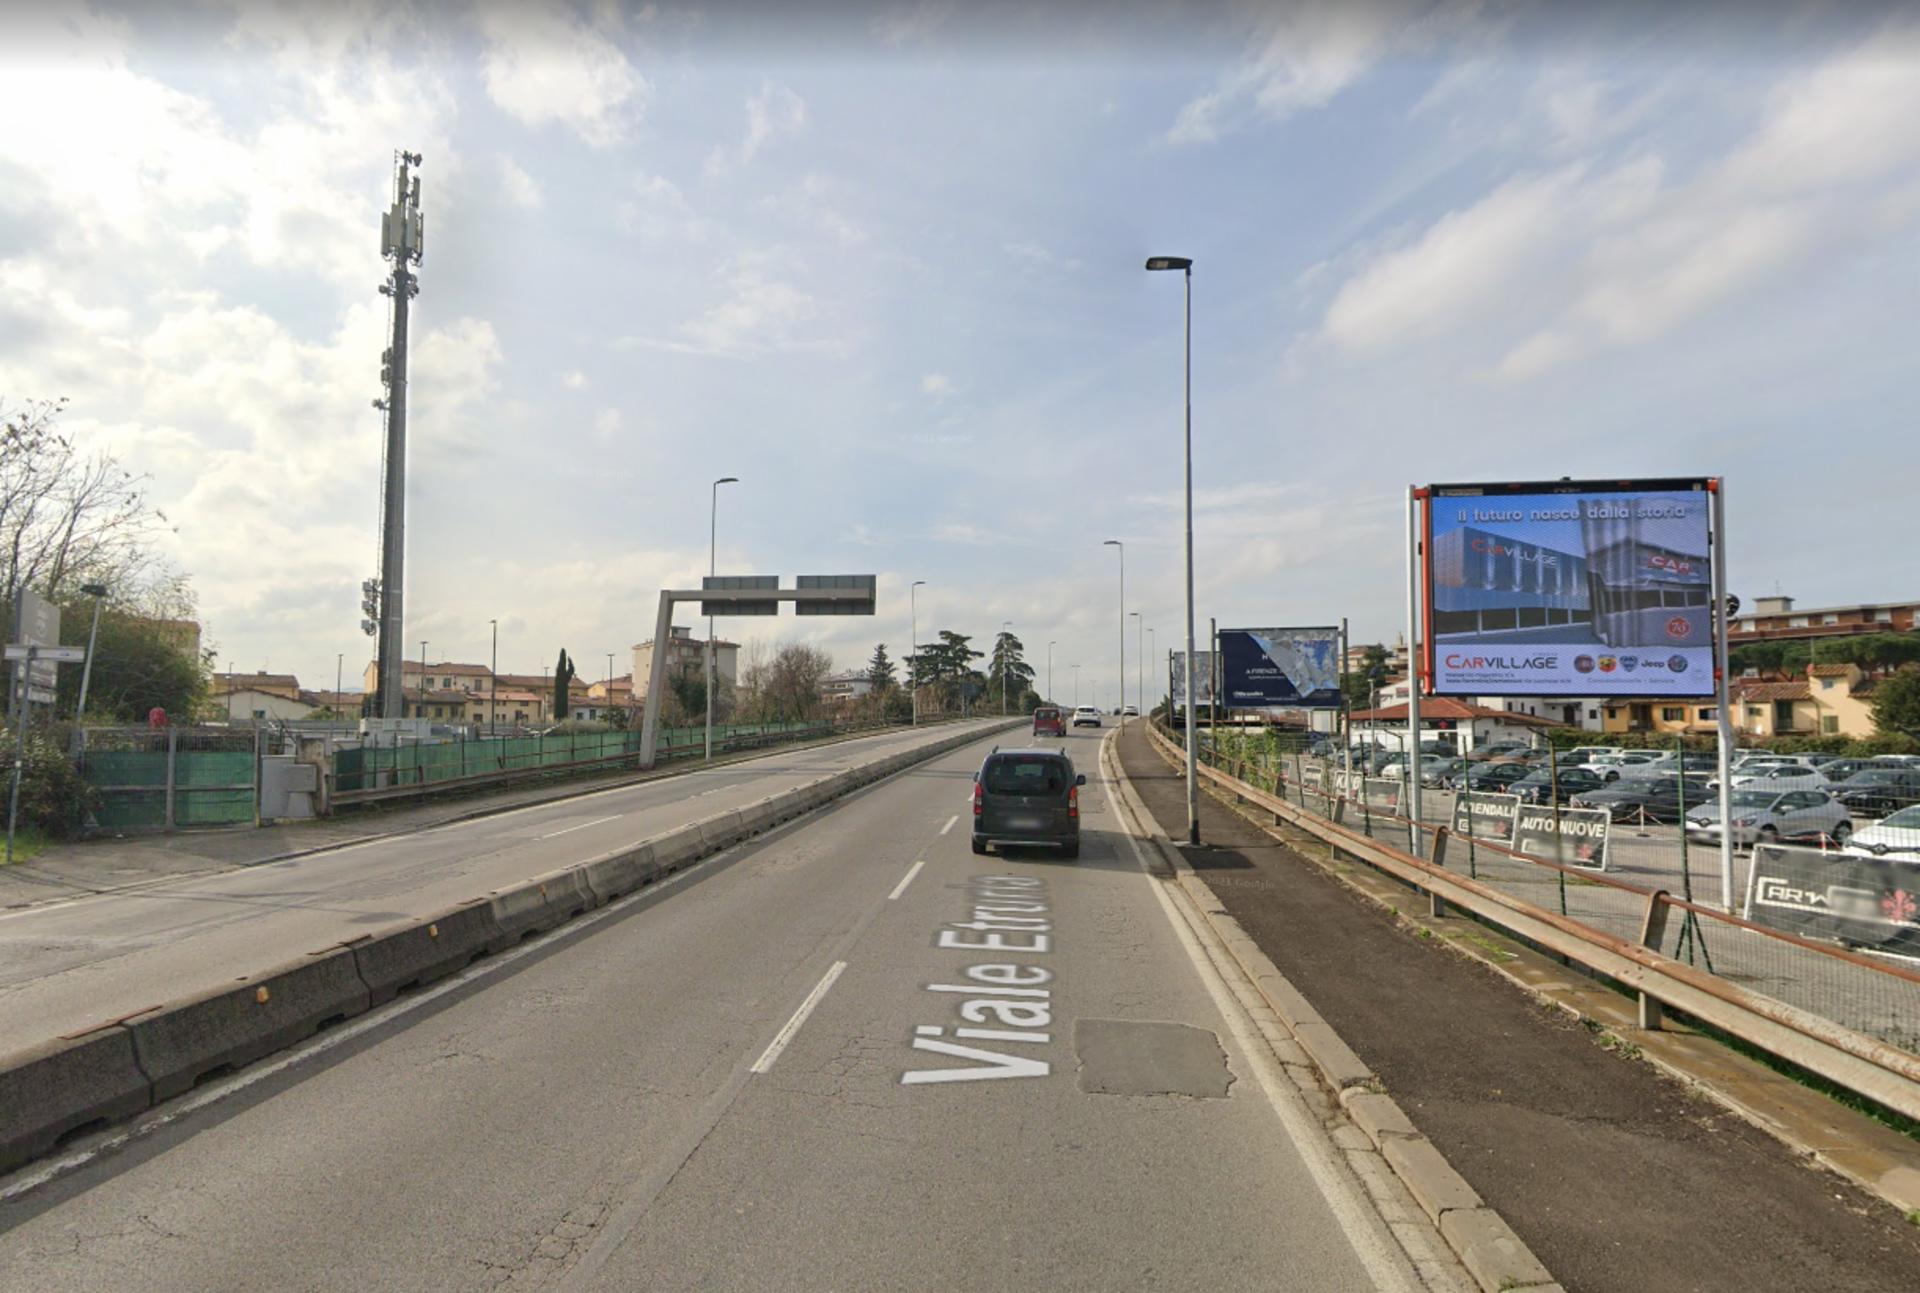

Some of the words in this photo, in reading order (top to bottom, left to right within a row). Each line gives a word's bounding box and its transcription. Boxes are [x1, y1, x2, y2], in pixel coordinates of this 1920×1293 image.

[1474, 508, 1523, 521] futuro
[1530, 508, 1580, 520] nasce
[1587, 505, 1629, 518] dalla
[1445, 654, 1559, 669] CARVILLAGE
[1641, 659, 1665, 669] Jeep
[1520, 817, 1554, 832] AUTO
[1558, 822, 1605, 837] NUOVE
